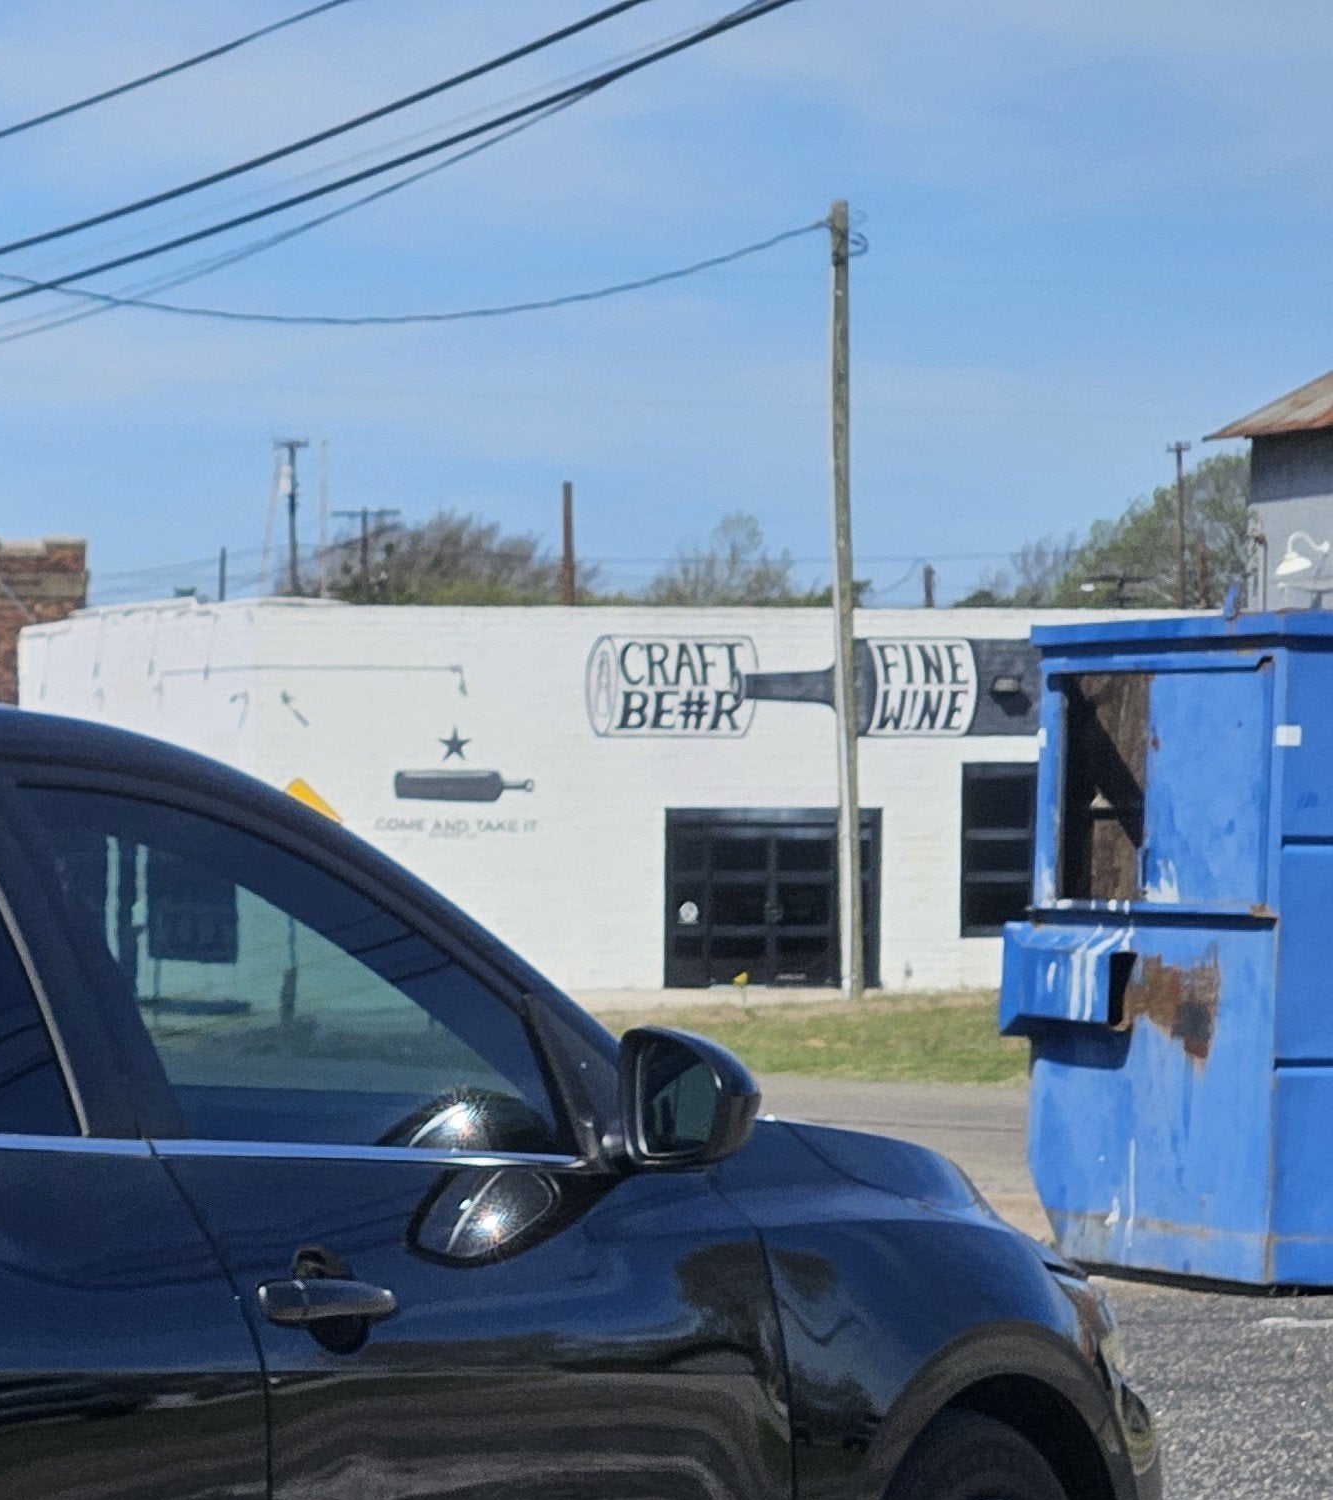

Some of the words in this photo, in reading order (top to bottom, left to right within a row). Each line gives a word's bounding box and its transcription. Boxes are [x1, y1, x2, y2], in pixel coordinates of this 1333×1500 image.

[620, 641, 743, 686] CRAFT
[876, 644, 970, 685] FINE
[373, 817, 425, 831] COME
[431, 818, 470, 833] AND
[476, 819, 518, 832] TAKE
[523, 818, 538, 832] IT
